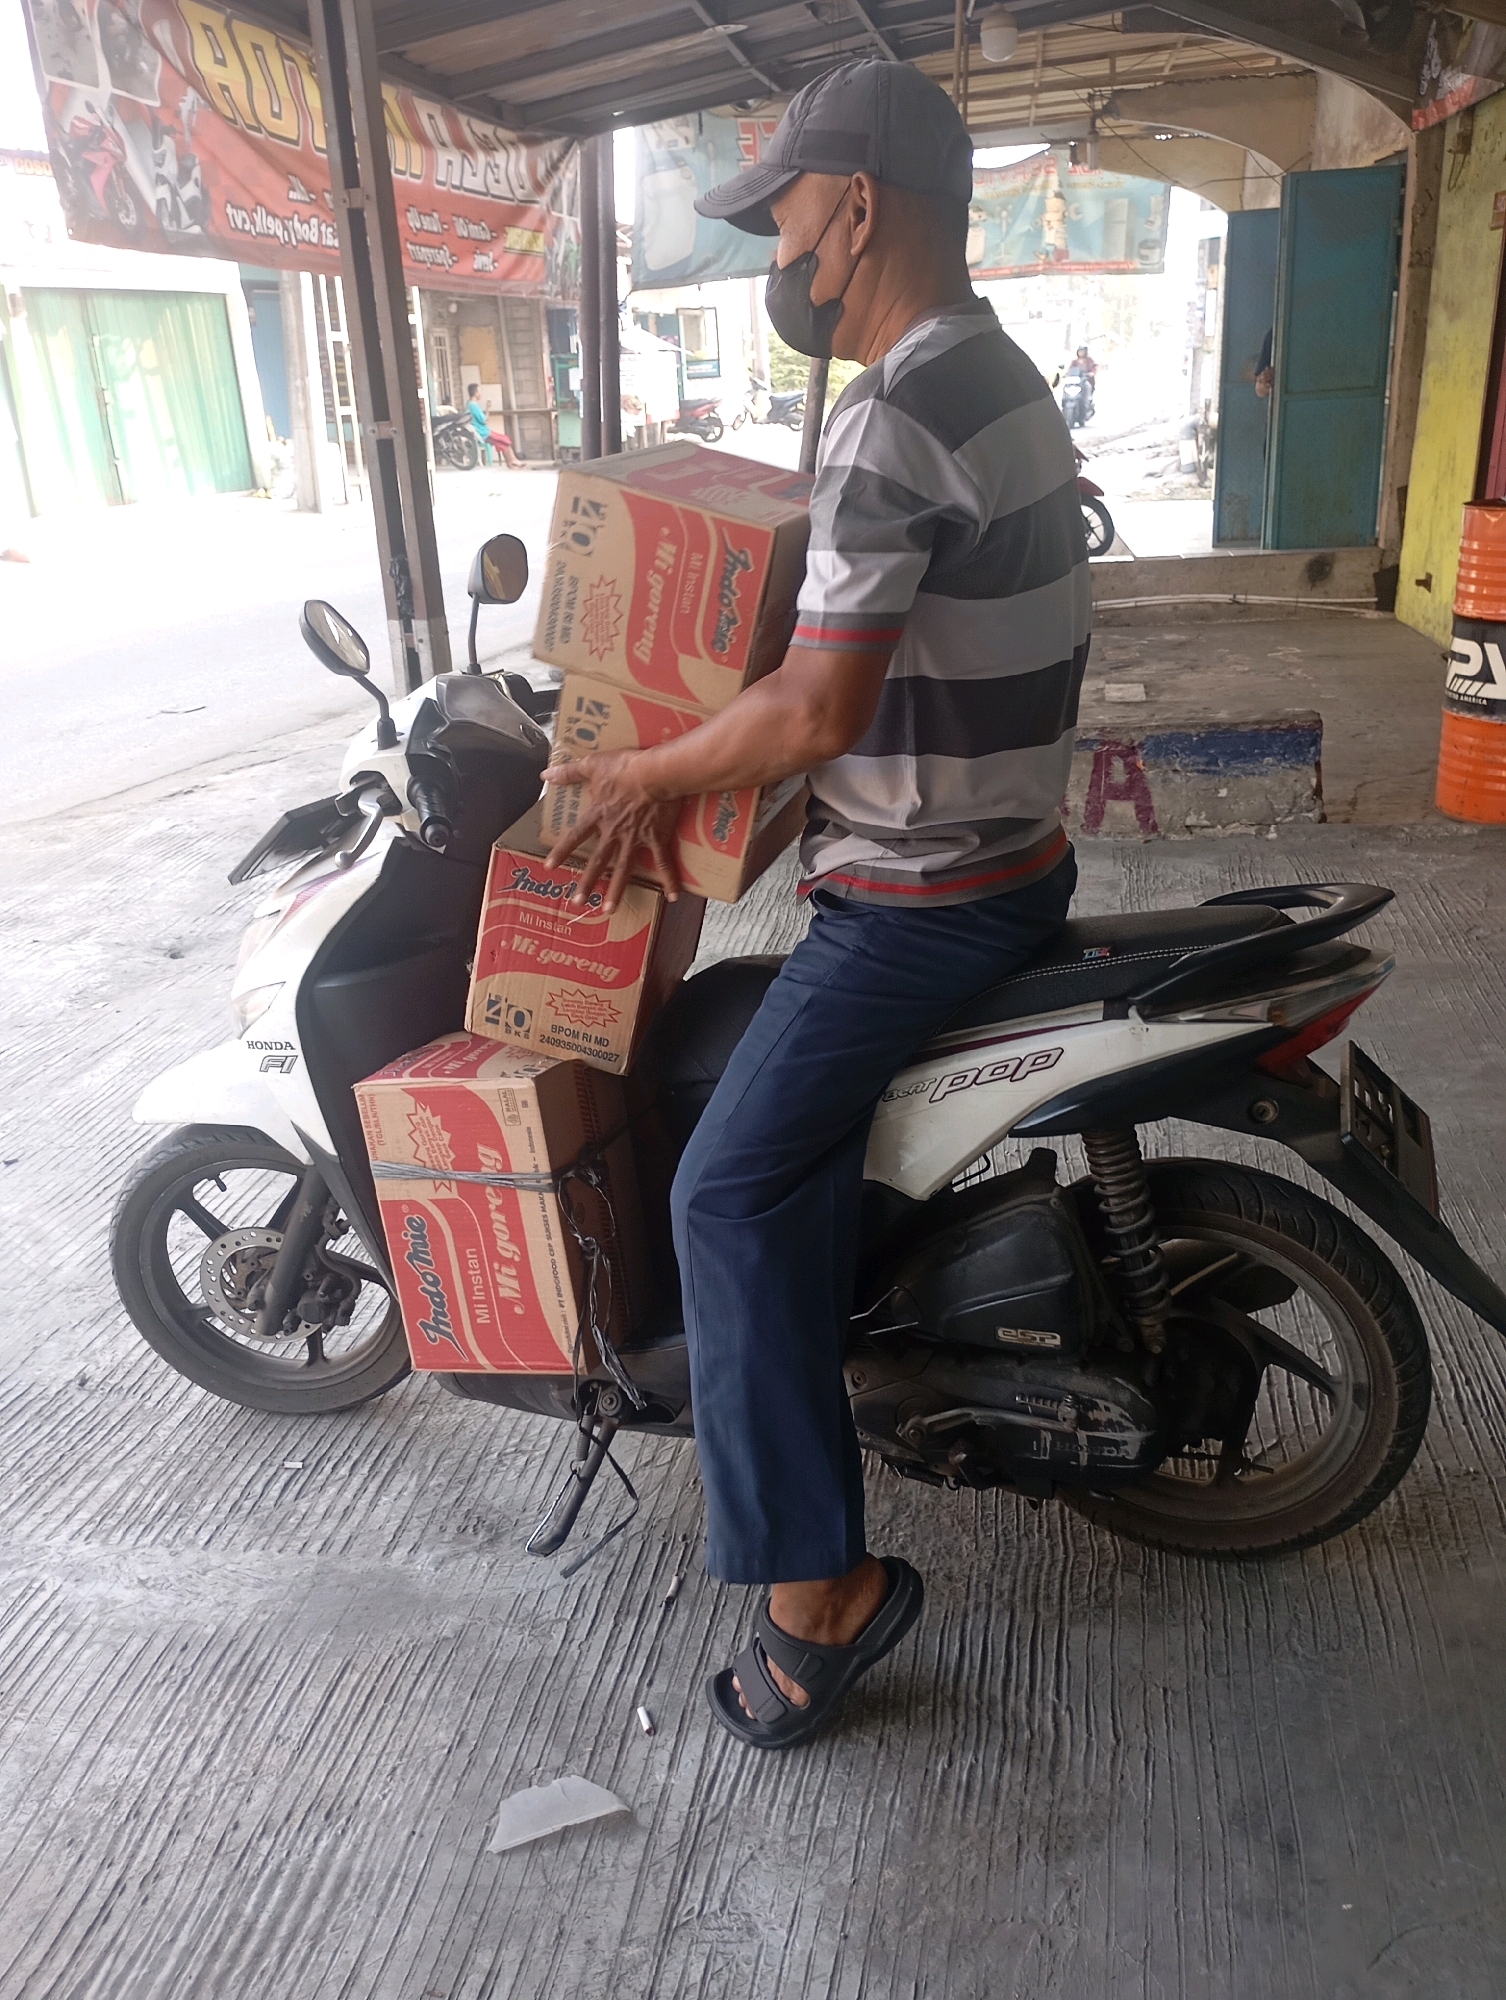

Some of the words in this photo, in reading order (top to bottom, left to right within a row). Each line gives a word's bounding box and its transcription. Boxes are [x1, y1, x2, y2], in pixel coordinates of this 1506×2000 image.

[569, 496, 603, 557] 40
[654, 527, 678, 575] Mi
[689, 552, 703, 571] Mi
[680, 571, 699, 615] Instan
[633, 569, 665, 665] goreng
[1460, 695, 1487, 706] AMERICA
[574, 696, 606, 750] 40
[498, 867, 603, 908] Indoe
[519, 911, 534, 926] Mi
[535, 915, 572, 936] Instan
[501, 934, 540, 956] Mi
[537, 948, 621, 982] goreng
[485, 999, 533, 1034] 40
[246, 1040, 296, 1050] HONDA
[539, 1034, 620, 1063] 240935004300027
[551, 1024, 580, 1041] BPOM
[582, 1032, 592, 1043] RI
[594, 1036, 609, 1048] MD
[259, 1054, 298, 1074] FI
[358, 1094, 371, 1129] SEBELUM
[501, 1090, 511, 1112] HALAL
[365, 1130, 378, 1161] UNAKAN
[538, 1191, 547, 1213] MAKM
[542, 1213, 552, 1241] SUKSES
[468, 1248, 485, 1303] Instan
[493, 1261, 525, 1315] Mi
[551, 1258, 564, 1298] INDOFOOD
[476, 1305, 491, 1324] Mi
